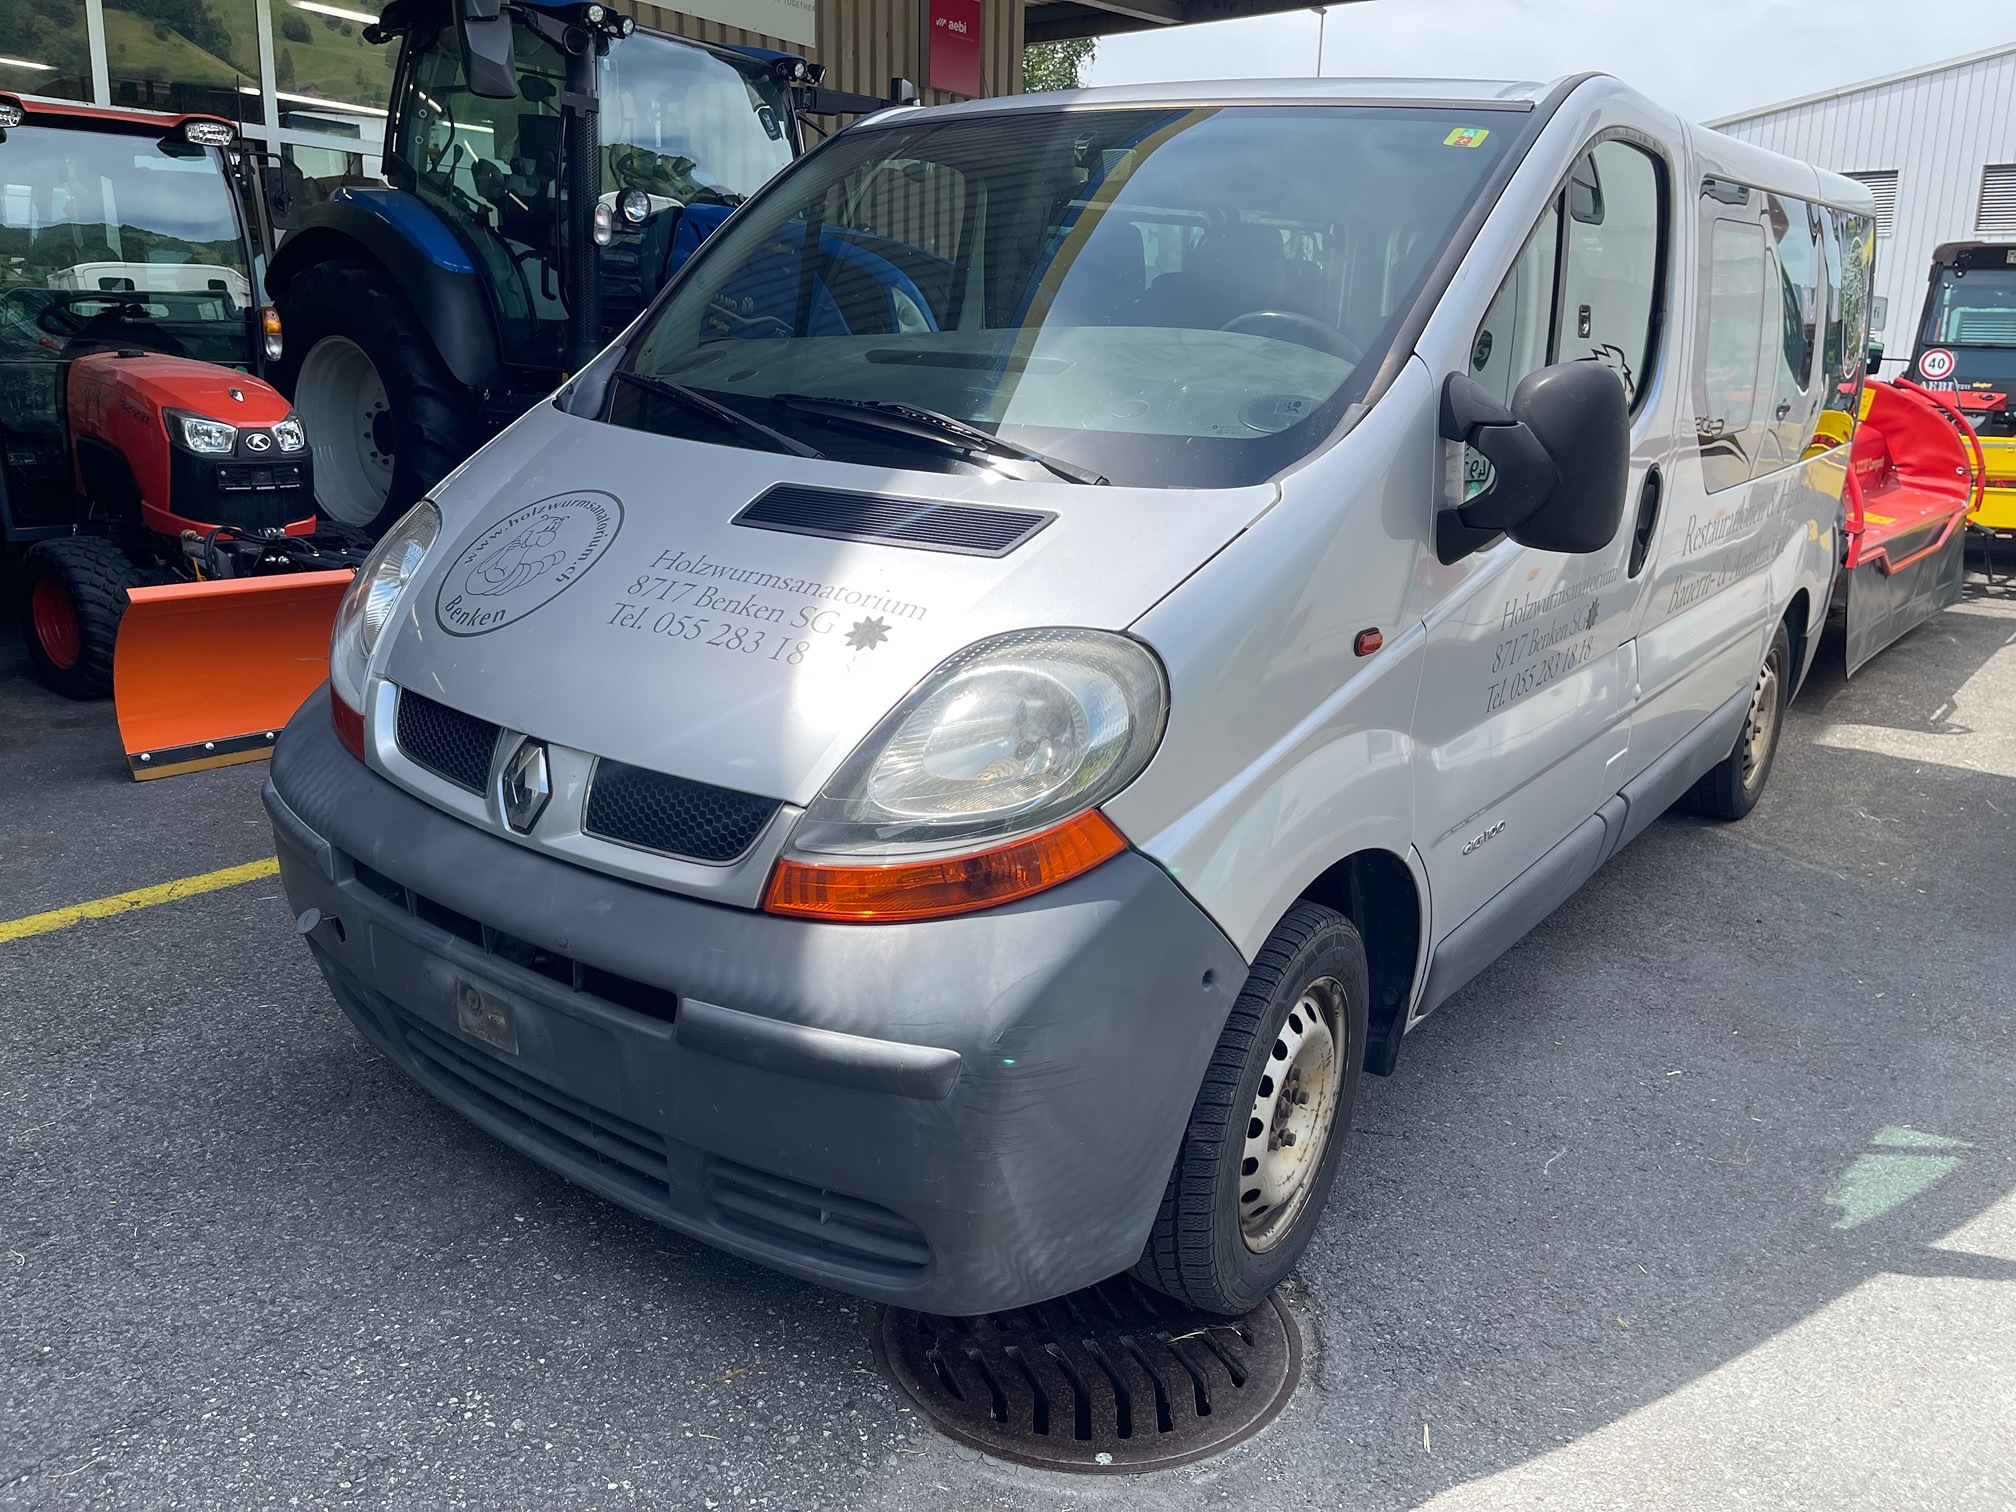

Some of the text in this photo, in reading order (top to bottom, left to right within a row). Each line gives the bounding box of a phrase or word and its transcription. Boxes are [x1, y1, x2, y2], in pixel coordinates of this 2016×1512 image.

[948, 20, 967, 34] aebi
[1928, 358, 1946, 370] 40
[465, 499, 611, 583] www.holzwurmsanatorium.ch
[445, 594, 507, 627] Benken
[627, 575, 841, 634] 8717 Benken SG
[650, 549, 928, 621] Holzwurmsanatorium
[1500, 567, 1618, 631] Holzwurmsanatorium
[1666, 573, 1715, 616] Bauern-
[605, 602, 650, 630] Tel.
[653, 611, 711, 640] 055
[706, 623, 766, 655] 283
[768, 637, 811, 666] 18
[1492, 604, 1590, 674] 8717 Benken SG
[1485, 677, 1508, 714] Tel.
[1510, 664, 1537, 700] 055
[1536, 652, 1561, 687] 283
[1561, 643, 1578, 673] 18
